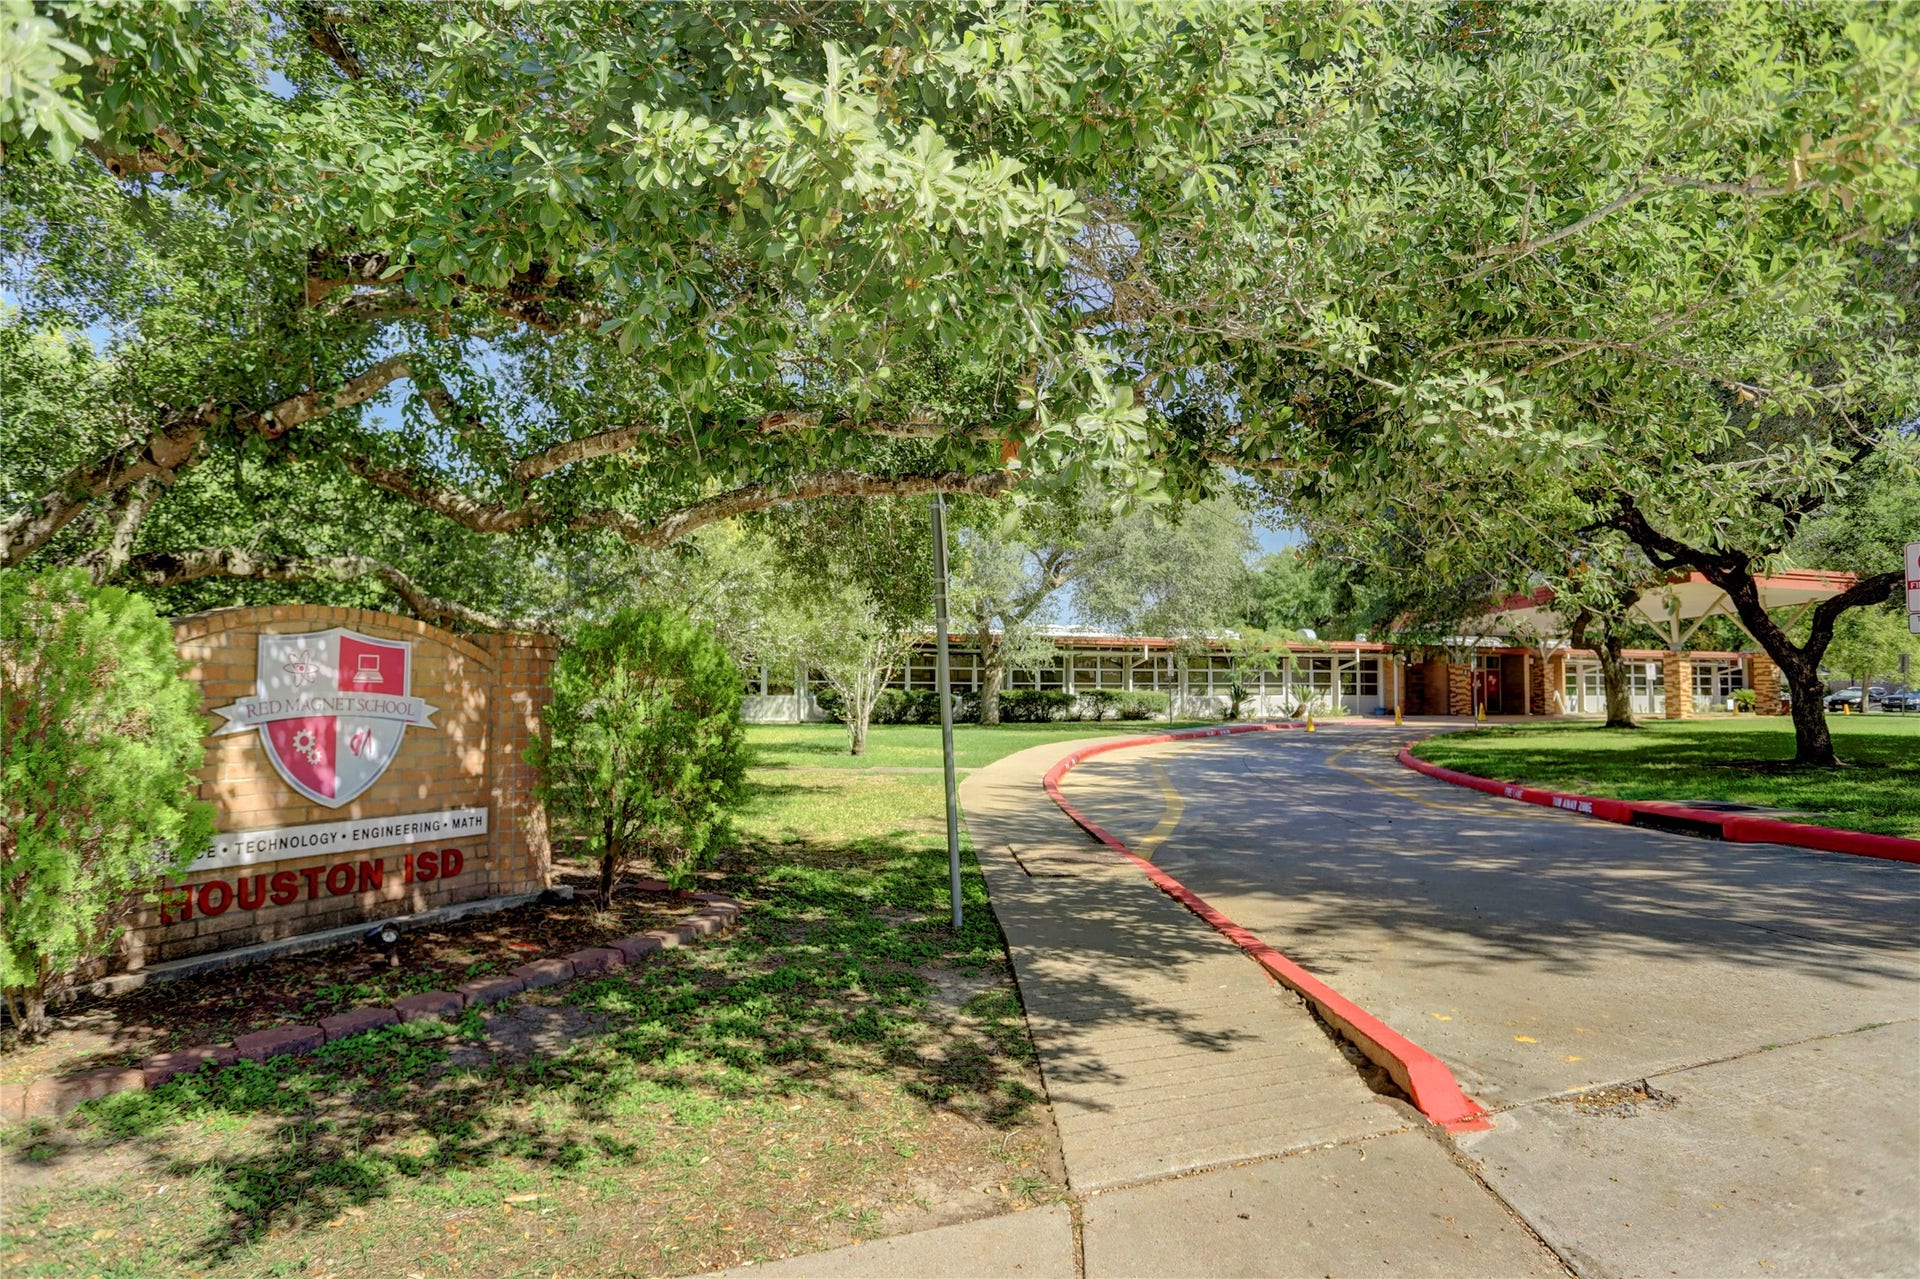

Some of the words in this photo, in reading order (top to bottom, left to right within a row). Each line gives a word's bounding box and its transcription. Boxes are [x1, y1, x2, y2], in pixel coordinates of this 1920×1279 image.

[247, 700, 282, 718] RED
[285, 697, 356, 713] MAGNET
[357, 699, 416, 716] SCHOOL
[235, 832, 337, 856] TECHNOLOGY
[352, 822, 440, 841] ENGINEERING
[452, 816, 483, 830] MATH
[160, 858, 384, 924] HOUSTON
[403, 849, 465, 885] ISD
